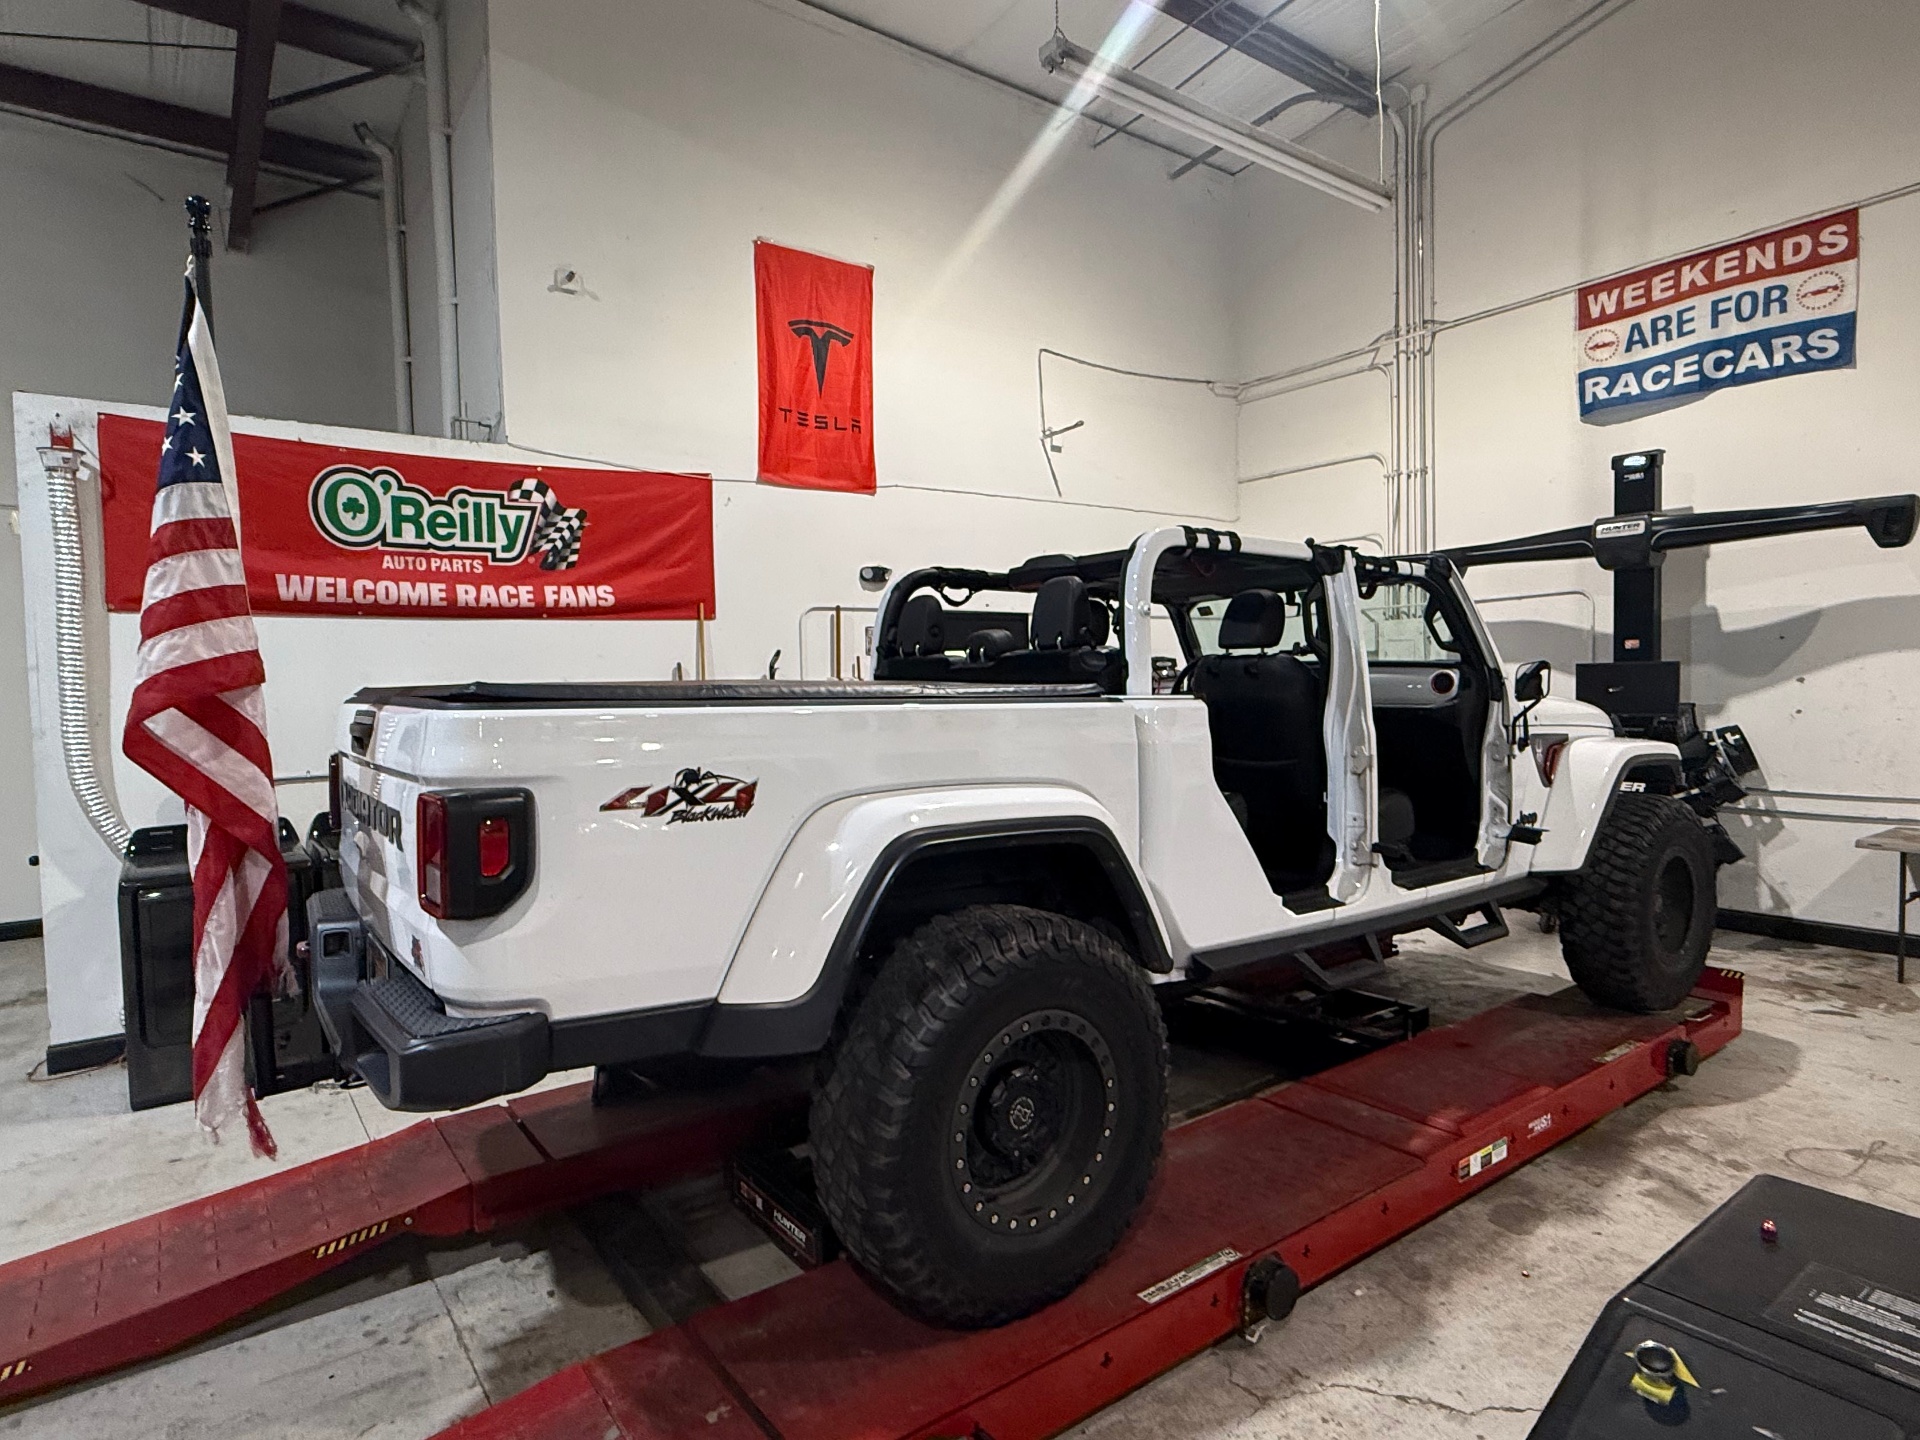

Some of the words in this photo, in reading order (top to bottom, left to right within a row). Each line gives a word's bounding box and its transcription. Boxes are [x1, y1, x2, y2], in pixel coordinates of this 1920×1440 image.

[1586, 223, 1849, 319] WEEKENDS
[1624, 305, 1696, 354] ARE
[1710, 284, 1789, 330] FOR
[1584, 328, 1841, 405] RACECARS
[778, 407, 862, 434] TESLA
[323, 476, 526, 554] O'Reilly
[1600, 522, 1641, 532] HUNTER
[382, 554, 427, 572] AUTO
[430, 556, 484, 574] PARTS
[275, 573, 448, 607] WELCOME
[456, 584, 536, 608] RACE
[545, 585, 616, 608] FANS
